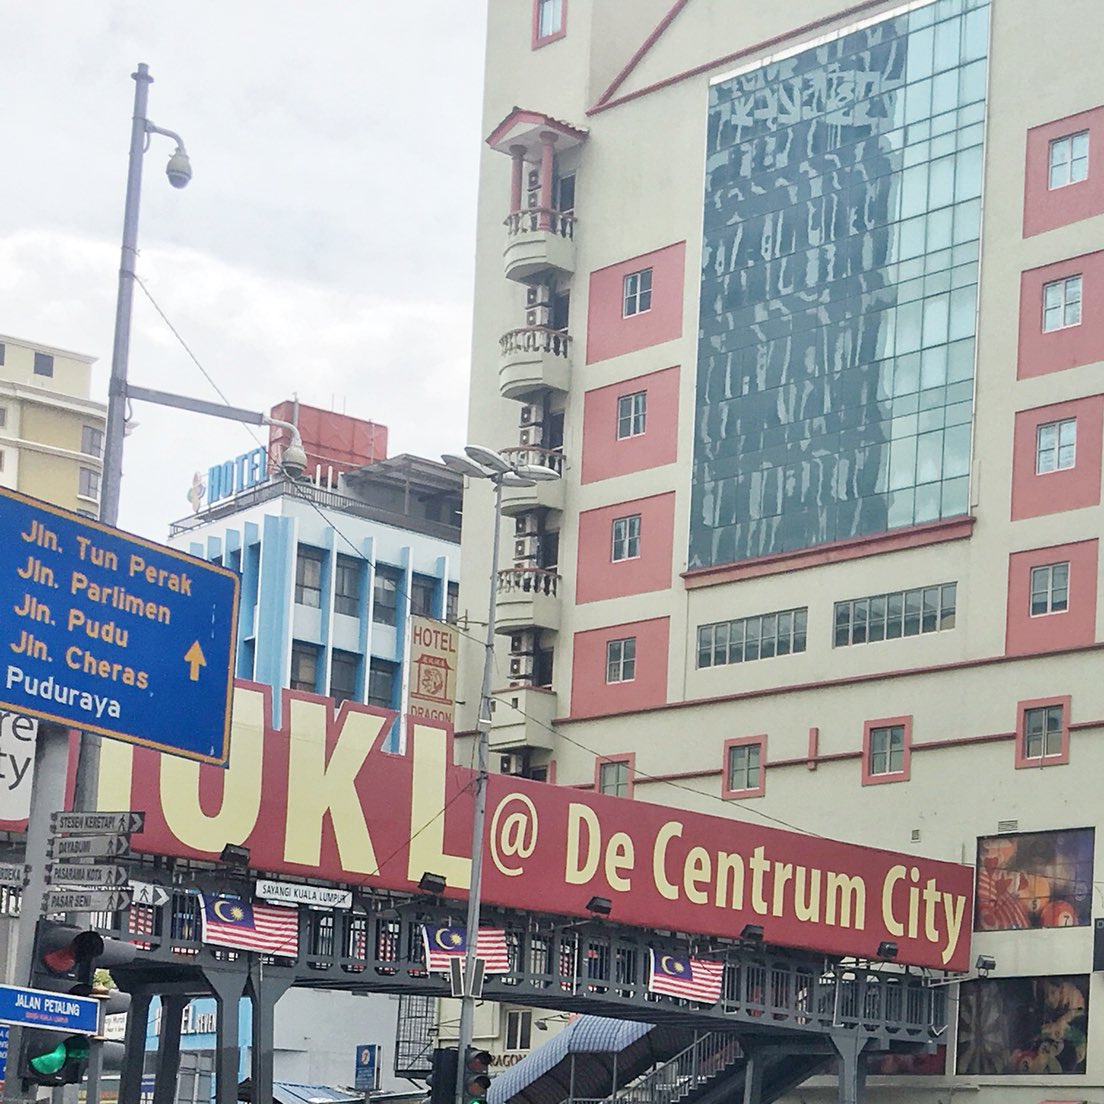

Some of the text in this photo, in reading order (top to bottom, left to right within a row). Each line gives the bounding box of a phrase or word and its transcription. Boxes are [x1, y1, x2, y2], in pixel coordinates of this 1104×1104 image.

[207, 446, 269, 504] HOTEL
[21, 520, 192, 597] Jln. Tun Perak
[17, 556, 171, 625] Jln. Parlimen
[14, 593, 129, 648] Jln. Pudu
[413, 625, 456, 653] HOTEL
[10, 631, 149, 689] Jln. Cheras
[5, 665, 121, 719] Puduraya
[410, 705, 452, 723] DRAGON
[84, 815, 115, 830] KERETAPI
[51, 895, 91, 910] PASAR SENI
[262, 884, 349, 904] SAYANGI KUALA LUMPUR
[490, 792, 539, 877] @
[565, 802, 635, 893] De
[653, 820, 868, 932] Centrum
[881, 864, 967, 965] City
[15, 994, 41, 1010] JALAN
[44, 999, 80, 1017] PETALING
